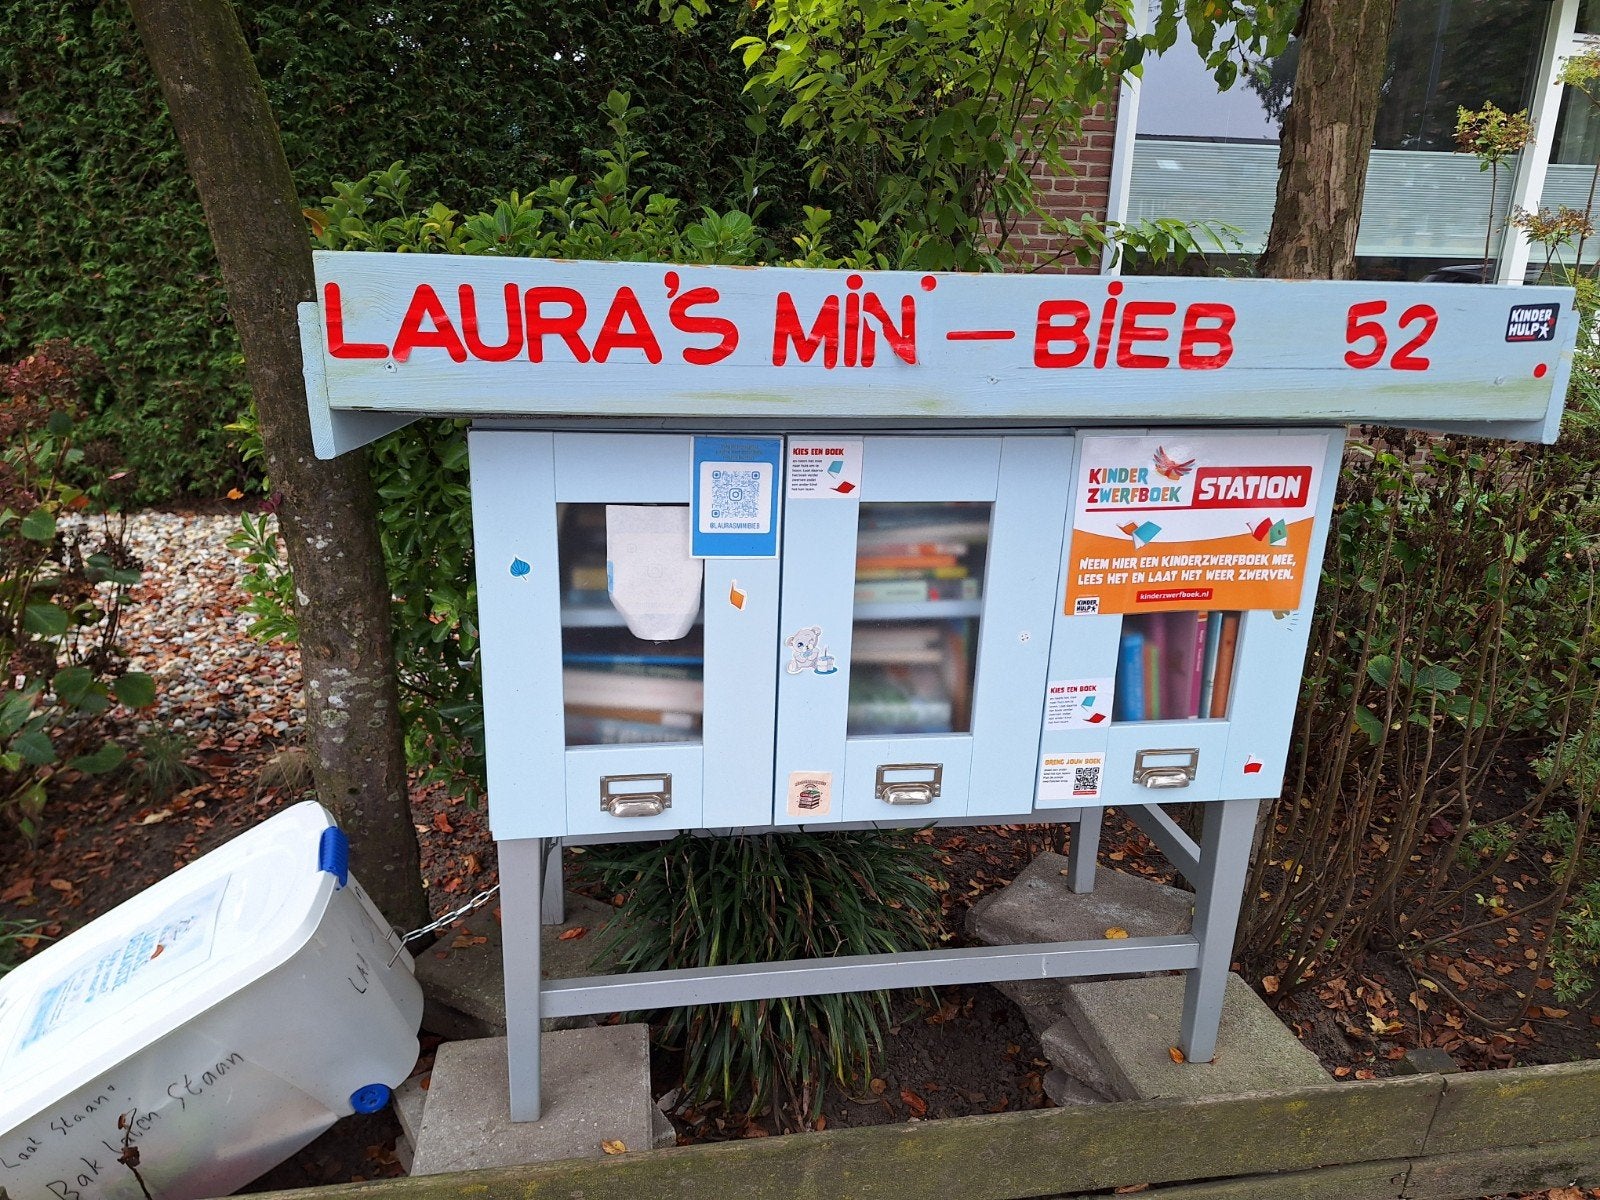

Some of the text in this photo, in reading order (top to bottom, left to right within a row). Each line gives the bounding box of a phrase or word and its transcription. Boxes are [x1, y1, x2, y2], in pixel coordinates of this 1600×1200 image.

[324, 271, 740, 366] LAURA'S
[1344, 300, 1439, 371] 52
[1510, 308, 1553, 322] KINDER
[1508, 322, 1540, 336] HULP
[792, 448, 845, 456] KIES EEN BOEK
[1088, 467, 1302, 501] KINDER STATION
[1087, 486, 1182, 504] ZWERFBOEK
[1079, 554, 1297, 570] NEEM HIER EEN KINDERZWERFBOEK MEE,
[1077, 569, 1294, 585] LEES HET EN LAAT HET WEER ZWERVEN.
[1139, 590, 1210, 600] kinderzwerfboek.nl
[167, 1052, 245, 1111] Staan
